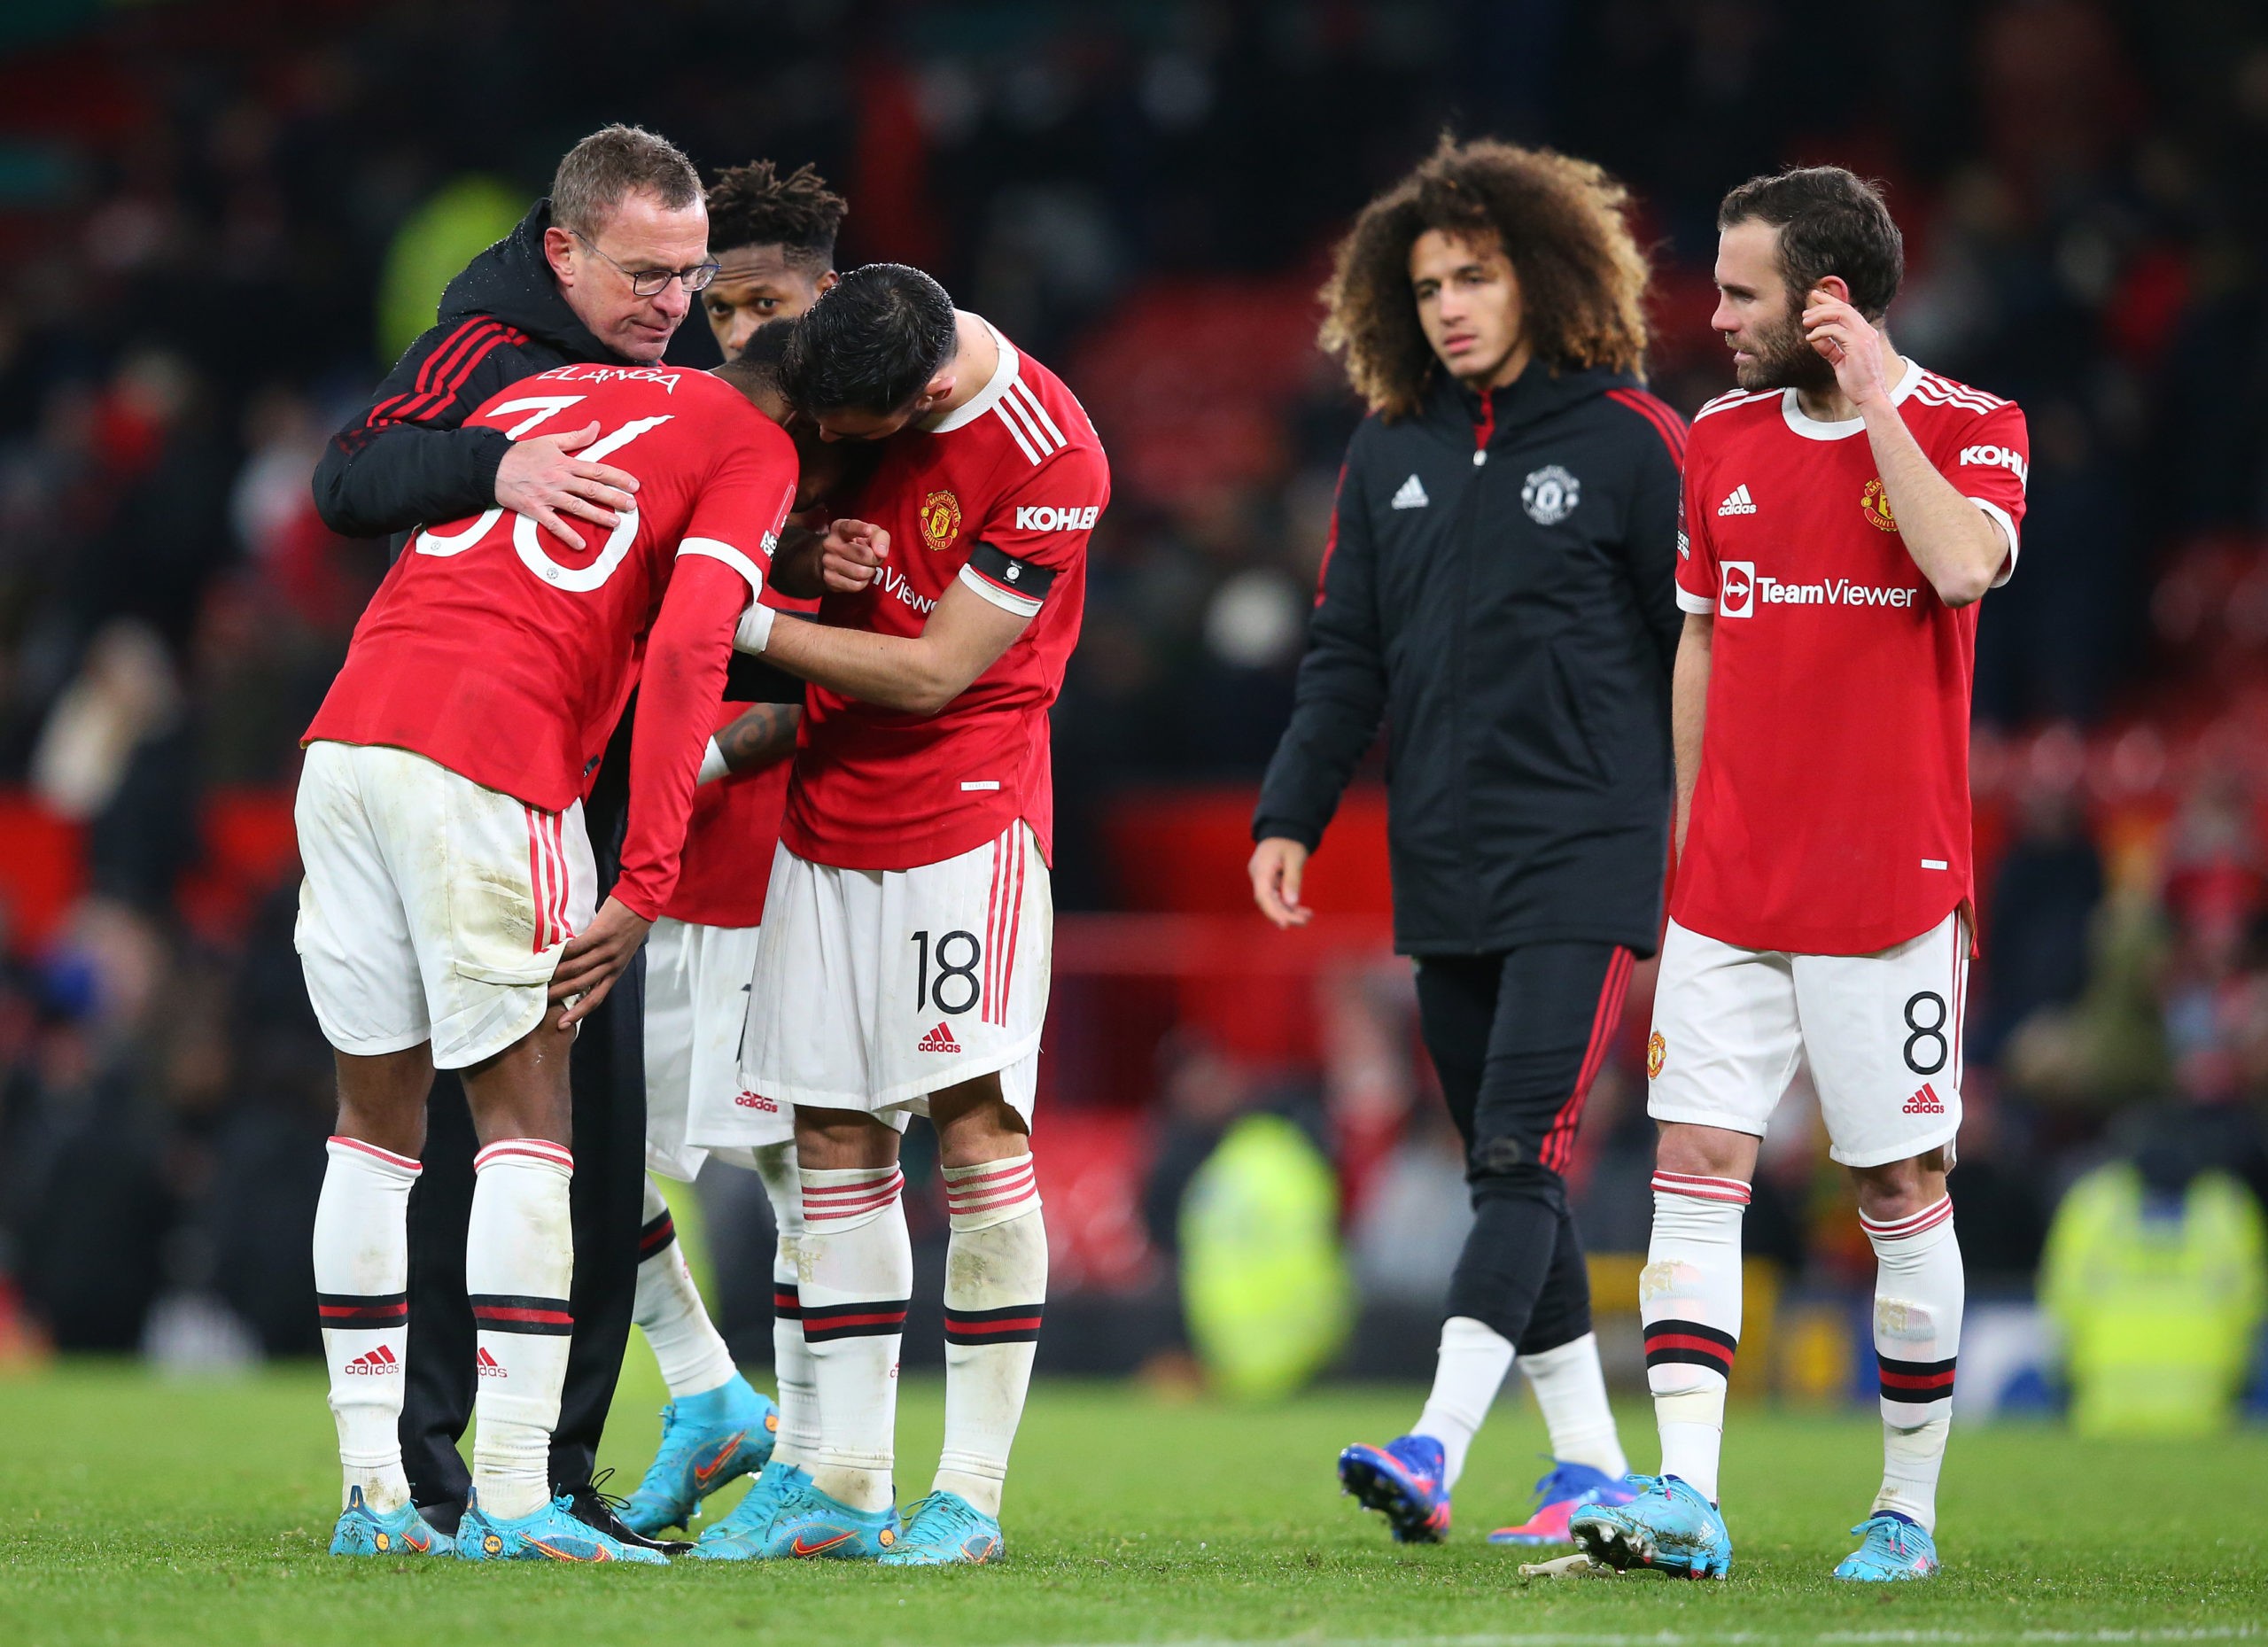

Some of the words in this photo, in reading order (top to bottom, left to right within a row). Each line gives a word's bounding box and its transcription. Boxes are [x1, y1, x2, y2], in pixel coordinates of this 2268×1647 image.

[536, 366, 681, 395] ELANGA
[1718, 502, 1757, 517] adidas
[1016, 506, 1099, 532] KOHLER
[924, 530, 946, 548] UNITED
[1756, 577, 1917, 609] TeamViewer
[911, 930, 981, 1014] 18
[1904, 991, 1948, 1075] 8
[918, 1039, 961, 1053] adidas
[735, 1095, 778, 1113] adidas
[1902, 1102, 1945, 1115] adidas
[345, 1362, 400, 1376] adidas
